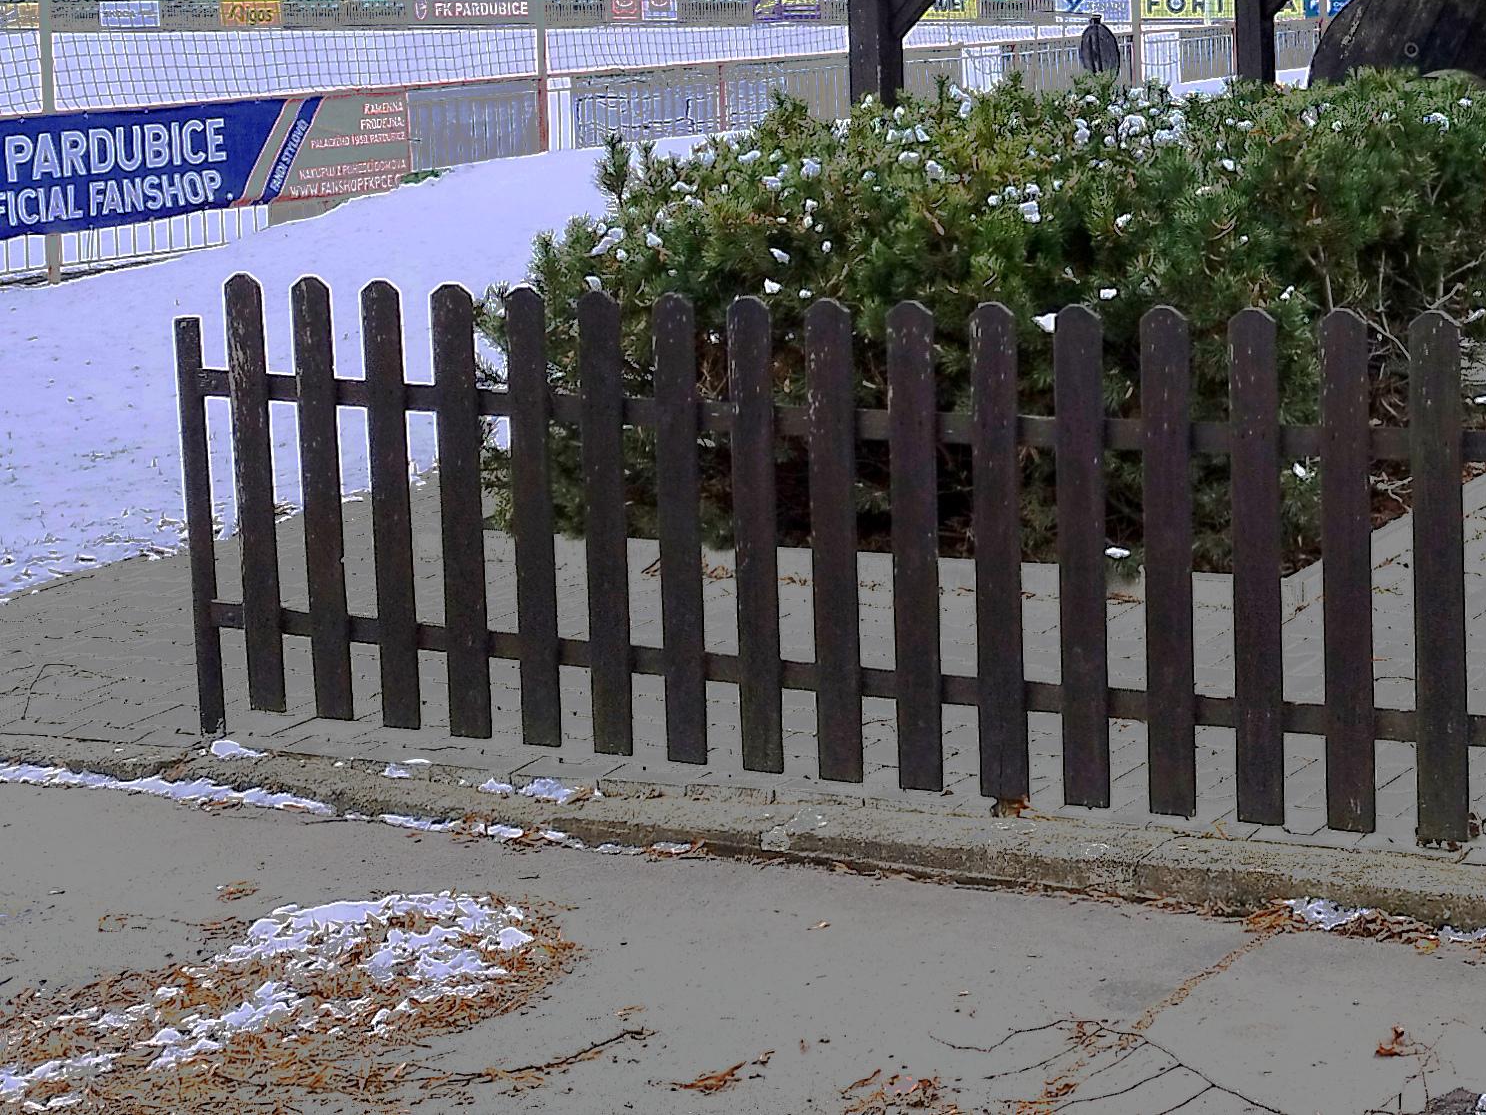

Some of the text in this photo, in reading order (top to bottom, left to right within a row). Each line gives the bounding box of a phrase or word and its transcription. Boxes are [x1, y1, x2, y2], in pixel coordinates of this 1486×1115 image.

[434, 1, 528, 17] FK PARDUBICE
[5, 118, 227, 183] PARDUBICE
[89, 170, 222, 216] FANSHOP
